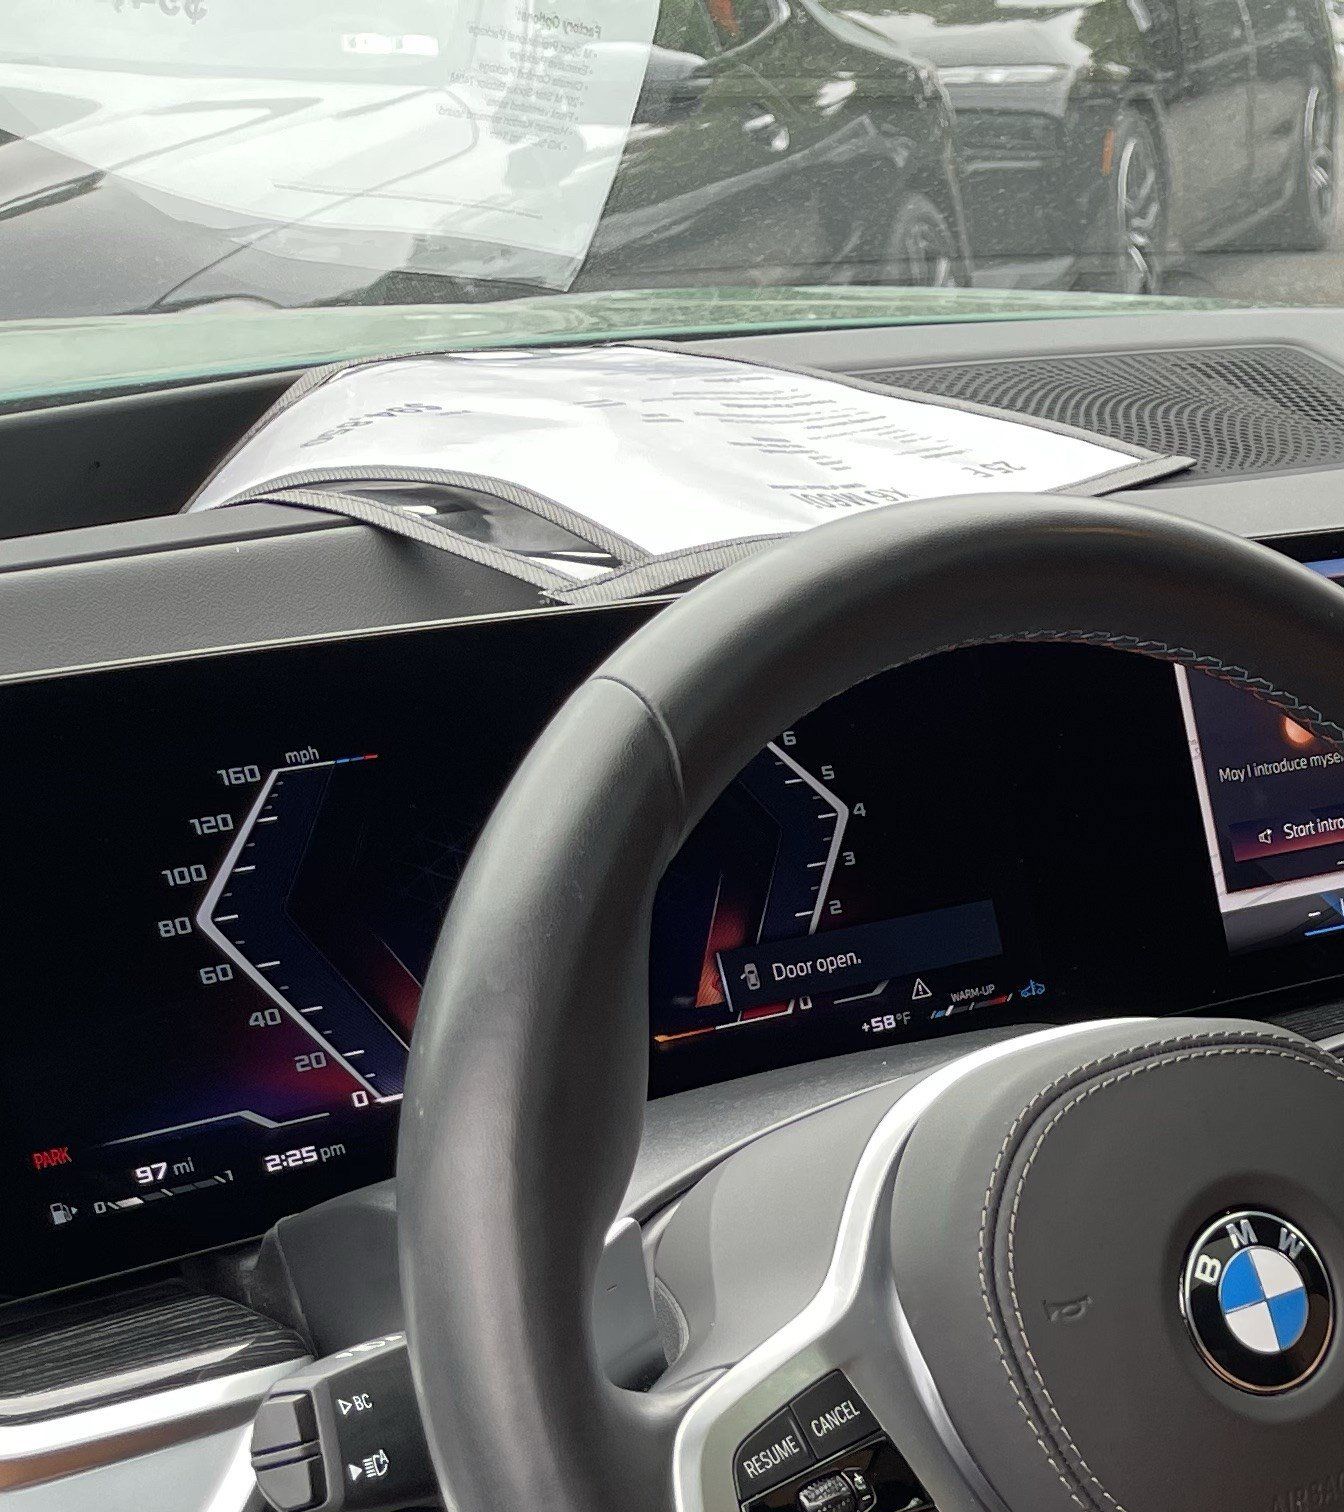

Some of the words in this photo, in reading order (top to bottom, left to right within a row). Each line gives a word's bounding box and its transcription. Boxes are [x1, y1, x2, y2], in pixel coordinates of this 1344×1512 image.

[782, 730, 797, 747] 6
[284, 745, 319, 766] mph
[217, 766, 261, 787] 160
[821, 765, 835, 781] 5
[1219, 767, 1245, 783] May
[1253, 756, 1308, 777] introduce
[853, 802, 867, 818] 4
[189, 813, 234, 836] 120
[1283, 822, 1315, 841] Start
[842, 851, 856, 866] 3
[162, 864, 207, 887] 100
[830, 900, 842, 915] 2
[157, 916, 193, 937] 80
[199, 964, 235, 985] 60
[772, 962, 812, 982] Door
[815, 949, 863, 976] open.
[950, 983, 996, 1003] WARM-UP
[248, 1008, 282, 1028] 40
[294, 1051, 327, 1072] 20
[351, 1091, 370, 1109] 0
[32, 1145, 73, 1172] PARK
[263, 1144, 319, 1174] 2:25
[320, 1140, 346, 1165] pm
[134, 1161, 168, 1185] 97
[173, 1157, 196, 1176] mi
[94, 1201, 107, 1215] 0
[1193, 1218, 1305, 1285] BMW
[354, 1393, 373, 1411] BC
[811, 1399, 861, 1438] CANCEL
[744, 1435, 801, 1479] RESUME
